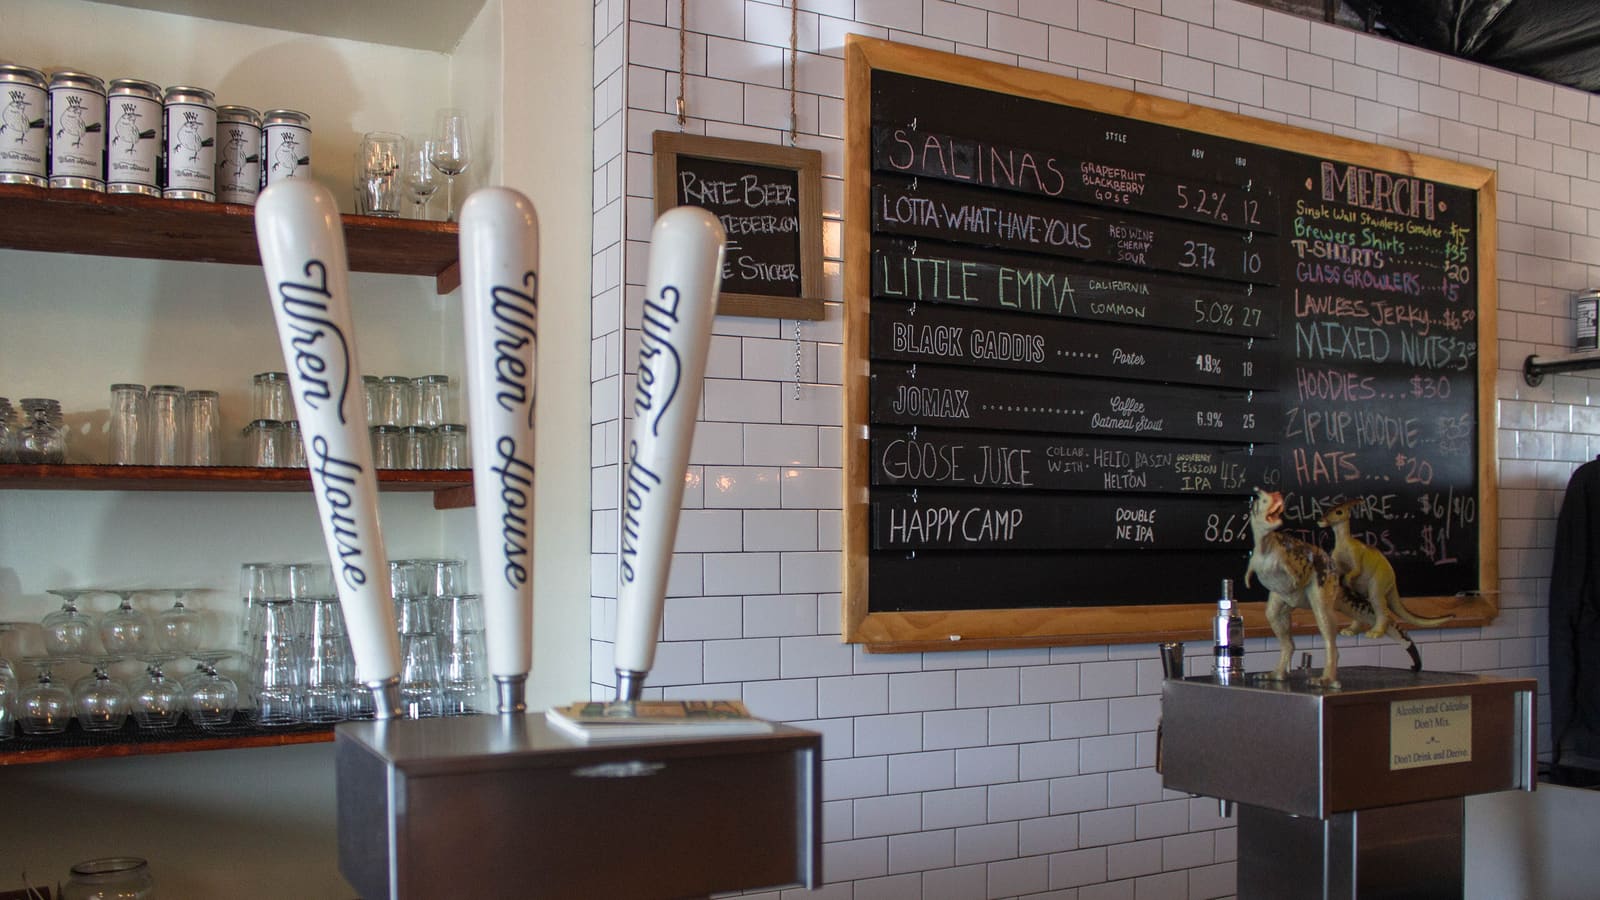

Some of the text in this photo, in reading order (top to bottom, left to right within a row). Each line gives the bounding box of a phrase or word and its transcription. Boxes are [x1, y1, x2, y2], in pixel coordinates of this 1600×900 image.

[1105, 131, 1128, 144] STYLE
[889, 130, 1064, 196] SALINAS
[1192, 149, 1204, 160] ABV
[1080, 162, 1146, 183] GRAPEFRUIT
[1082, 174, 1145, 196] BLACKBERRY
[680, 171, 796, 208] RATE BEER
[1095, 189, 1130, 205] GOSE
[1321, 161, 1436, 222] MERCH
[1177, 185, 1261, 225] 5.2% 12
[1296, 199, 1330, 220] Single
[1332, 207, 1357, 223] Wall
[1360, 212, 1404, 233] Stainless
[1406, 221, 1442, 238] Growler
[883, 194, 1092, 249] LOTTA WHAT HAVE YOUS
[1109, 224, 1154, 243] RED WINE
[1294, 216, 1356, 246] Brewers
[1360, 227, 1406, 255] Shirts
[1116, 252, 1146, 265] SOUR
[1117, 239, 1151, 253] CHERRY
[1178, 240, 1262, 274] 3.7% 10
[738, 256, 799, 282] STICKER
[1290, 239, 1470, 284] T-SHIRTS $20
[884, 255, 1078, 314] LITTLE EMMA
[1088, 280, 1150, 296] CALIFORNIA
[1296, 262, 1340, 284] GLASS
[1342, 269, 1421, 296] GROWLERS
[1090, 302, 1146, 318] COMMON
[1194, 300, 1262, 328] 5.0% 27
[1294, 288, 1370, 318] LAWLESS
[893, 322, 1046, 364] BLACK CADDIS
[1112, 348, 1146, 367] Porter
[1296, 321, 1390, 364] MIXED
[1400, 330, 1450, 368] NUTS
[1196, 354, 1253, 377] 4.8% 18
[1296, 367, 1451, 402] HOODIES $30
[892, 385, 970, 419] JOMAX
[1110, 396, 1146, 417] Coffee
[278, 259, 367, 592] Wren House
[490, 270, 538, 590] Wren House
[1090, 412, 1164, 432] Oatmeal Stout
[1196, 411, 1255, 429] 6.9% 25
[1284, 408, 1322, 446] ZIP
[1324, 409, 1351, 445] UP
[1354, 408, 1419, 449] HOODIE
[620, 285, 682, 587] Wren House
[882, 439, 1034, 487] GOOSE JUICE
[1135, 451, 1172, 469] BASIN
[1174, 462, 1217, 475] SESSION
[1293, 448, 1433, 485] HATS $20
[1104, 472, 1147, 490] HELTON
[1180, 476, 1212, 491] IPA
[1263, 466, 1281, 485] 60
[889, 506, 1024, 544] HAPPY CAMP
[1116, 507, 1157, 524] DOUBLE
[1204, 513, 1249, 543] 8.6%
[1116, 524, 1155, 543] NE IPA
[1420, 524, 1458, 566] $1
